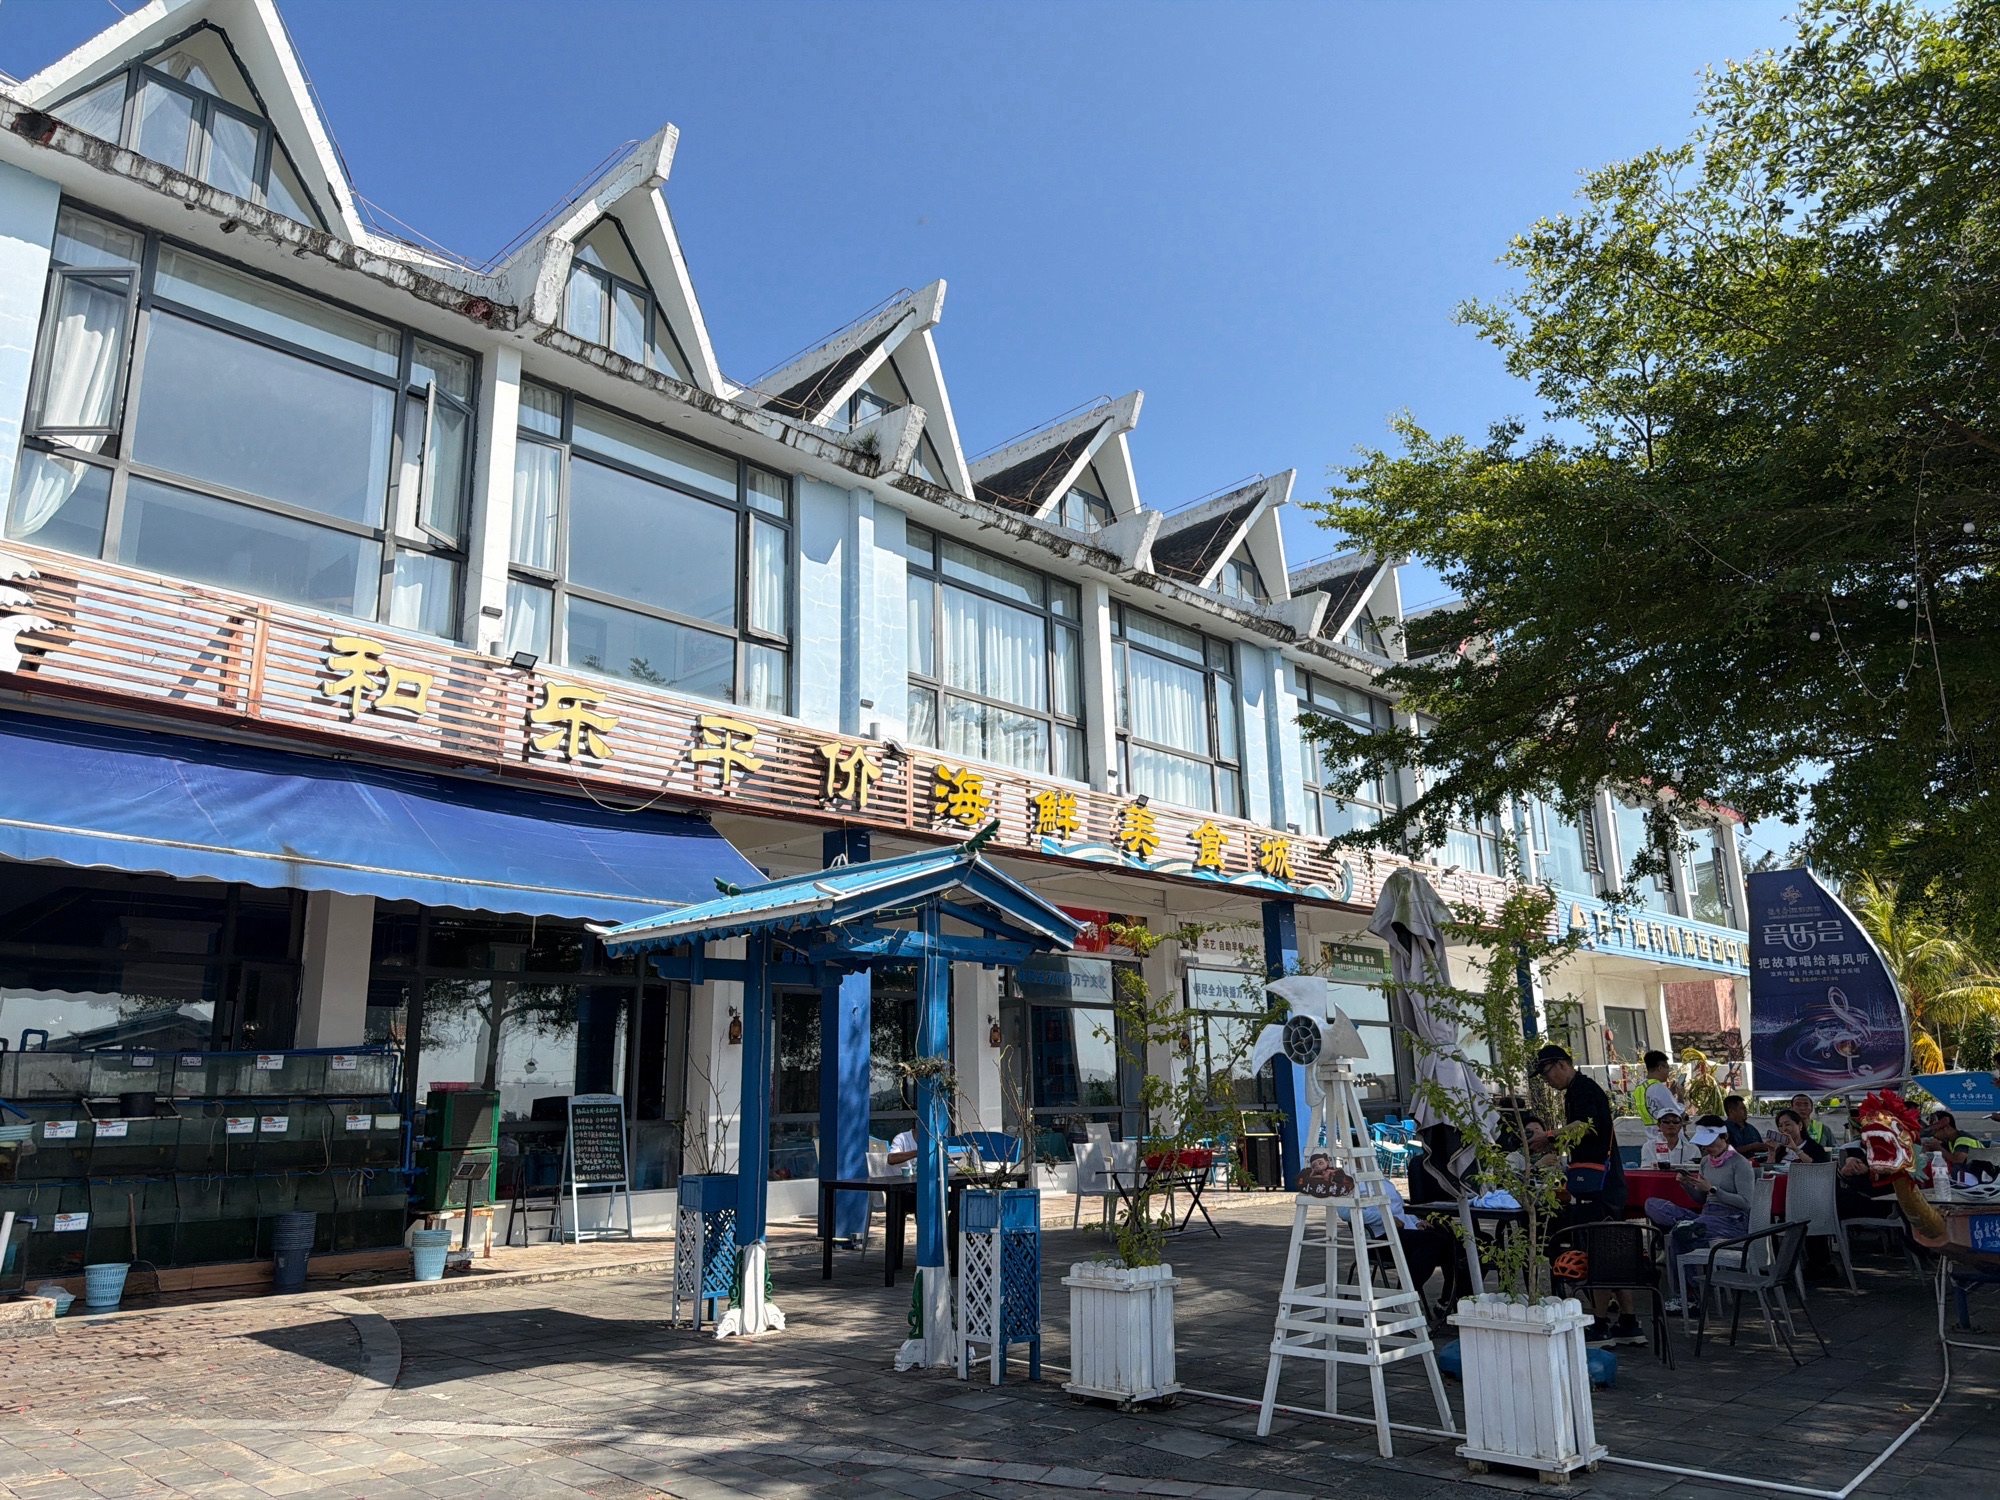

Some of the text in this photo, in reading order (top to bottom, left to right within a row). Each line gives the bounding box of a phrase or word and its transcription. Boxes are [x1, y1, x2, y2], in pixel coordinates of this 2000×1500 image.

[1202, 938, 1217, 950] 茶艺
[1762, 919, 1844, 952] 音乐会
[1757, 952, 1870, 970] 把故事唱给海风听
